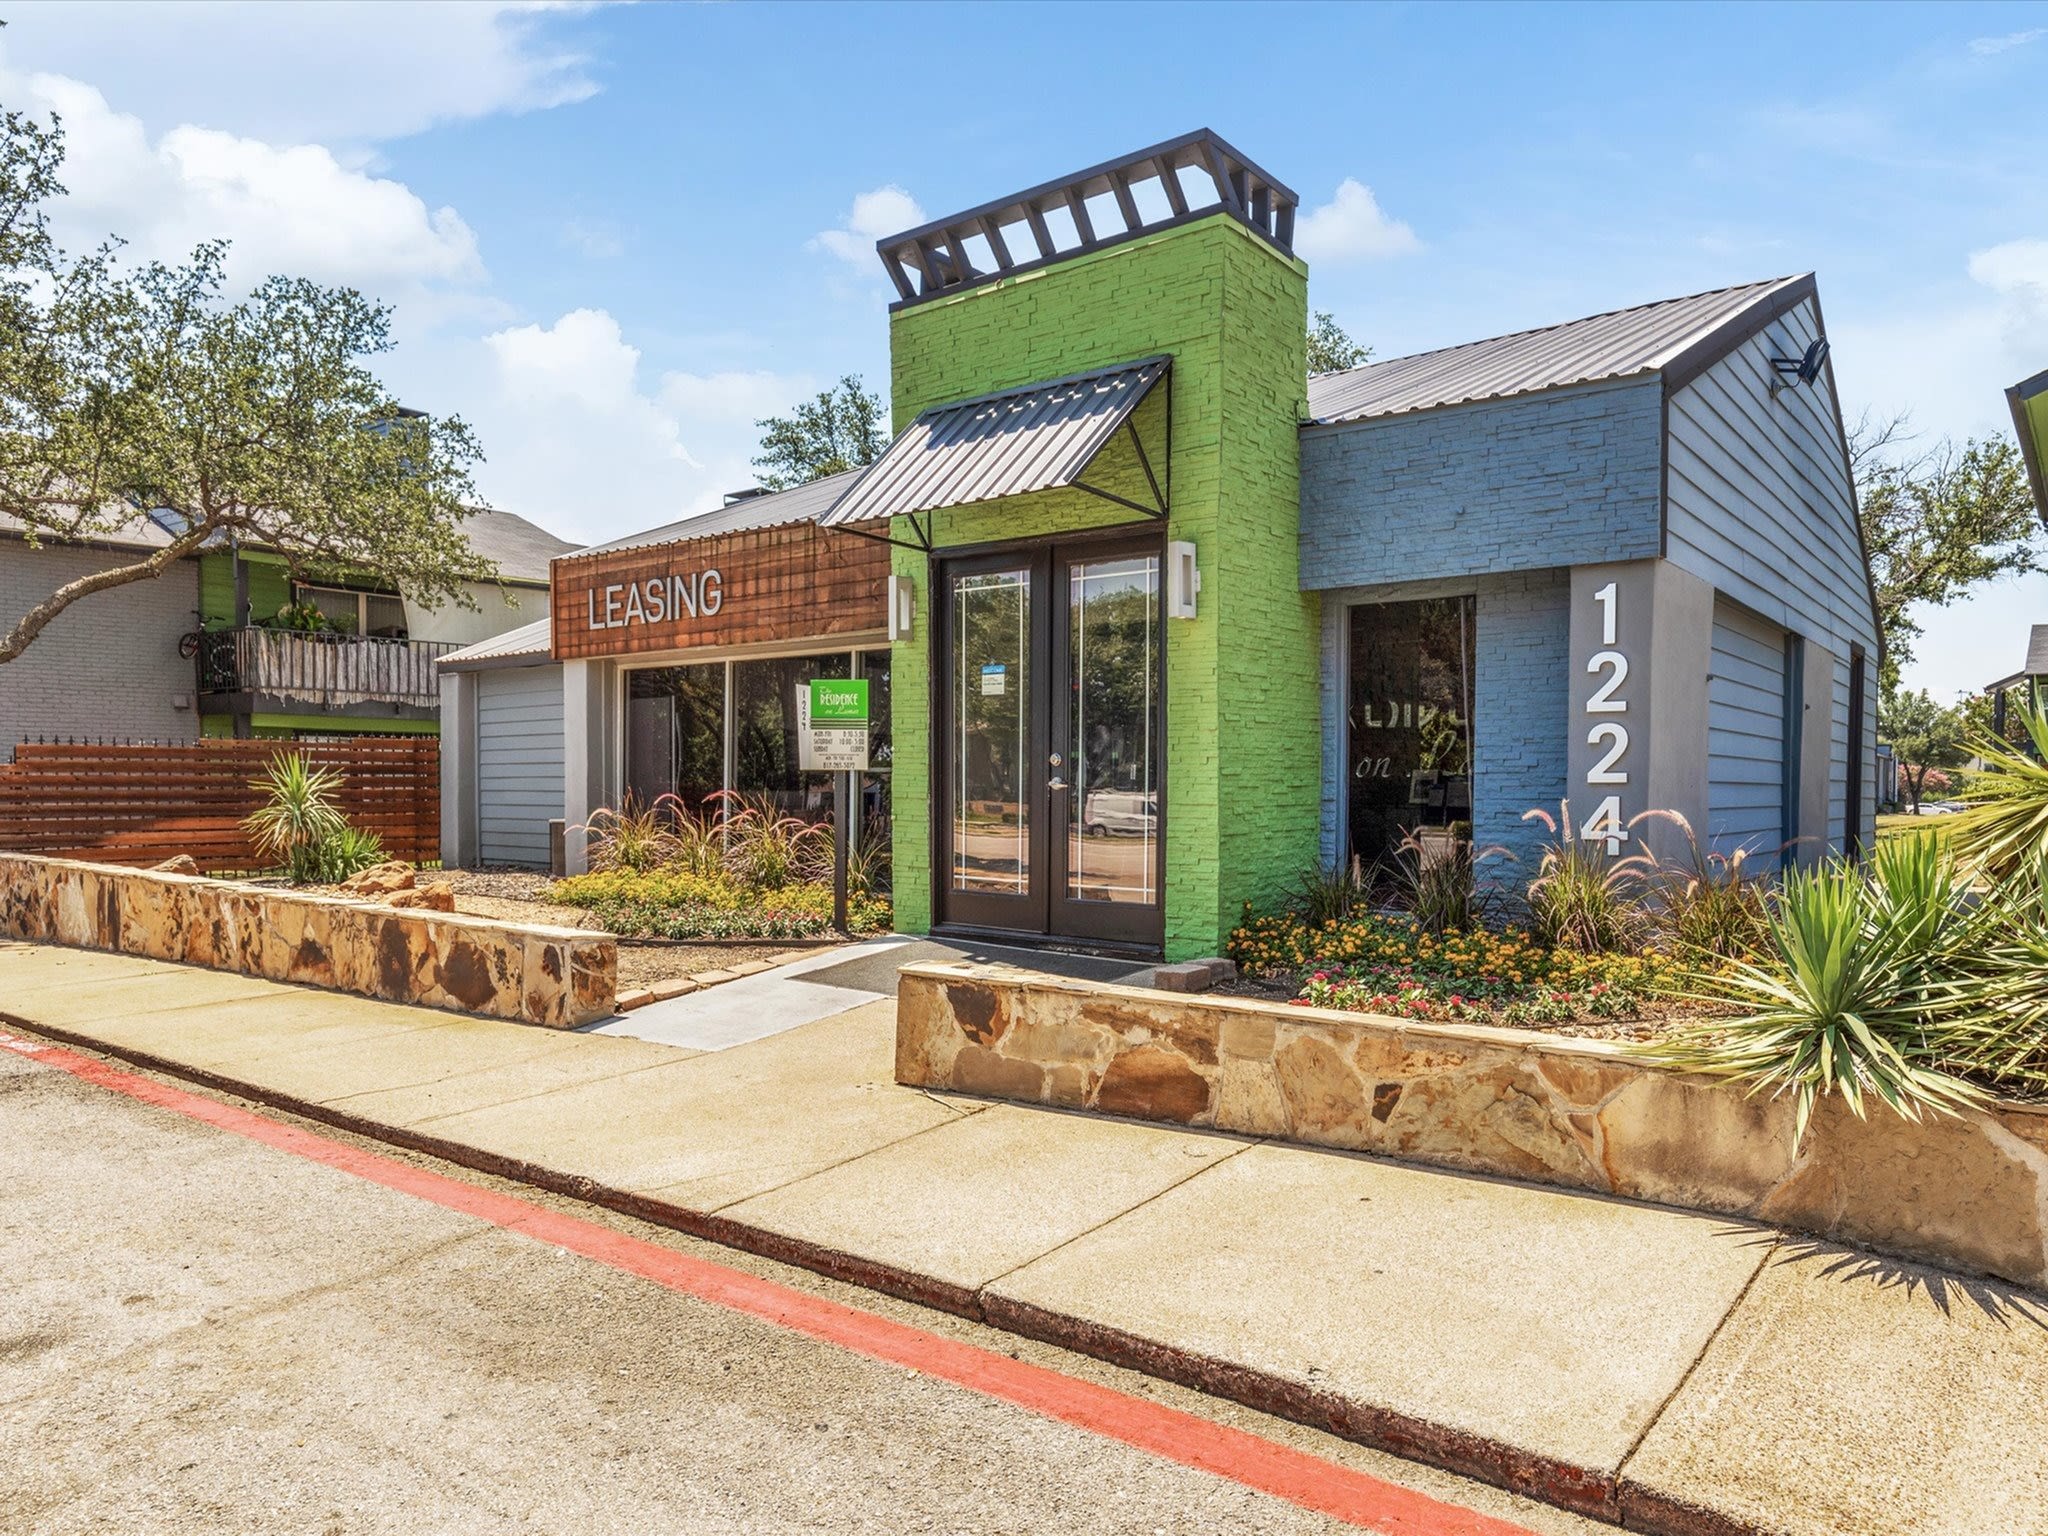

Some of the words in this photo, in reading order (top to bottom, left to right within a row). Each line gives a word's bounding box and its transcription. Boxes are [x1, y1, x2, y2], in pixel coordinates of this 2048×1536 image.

[588, 569, 722, 631] LEASING
[820, 693, 858, 705] RESIDENCE
[1580, 582, 1629, 856] 1224
